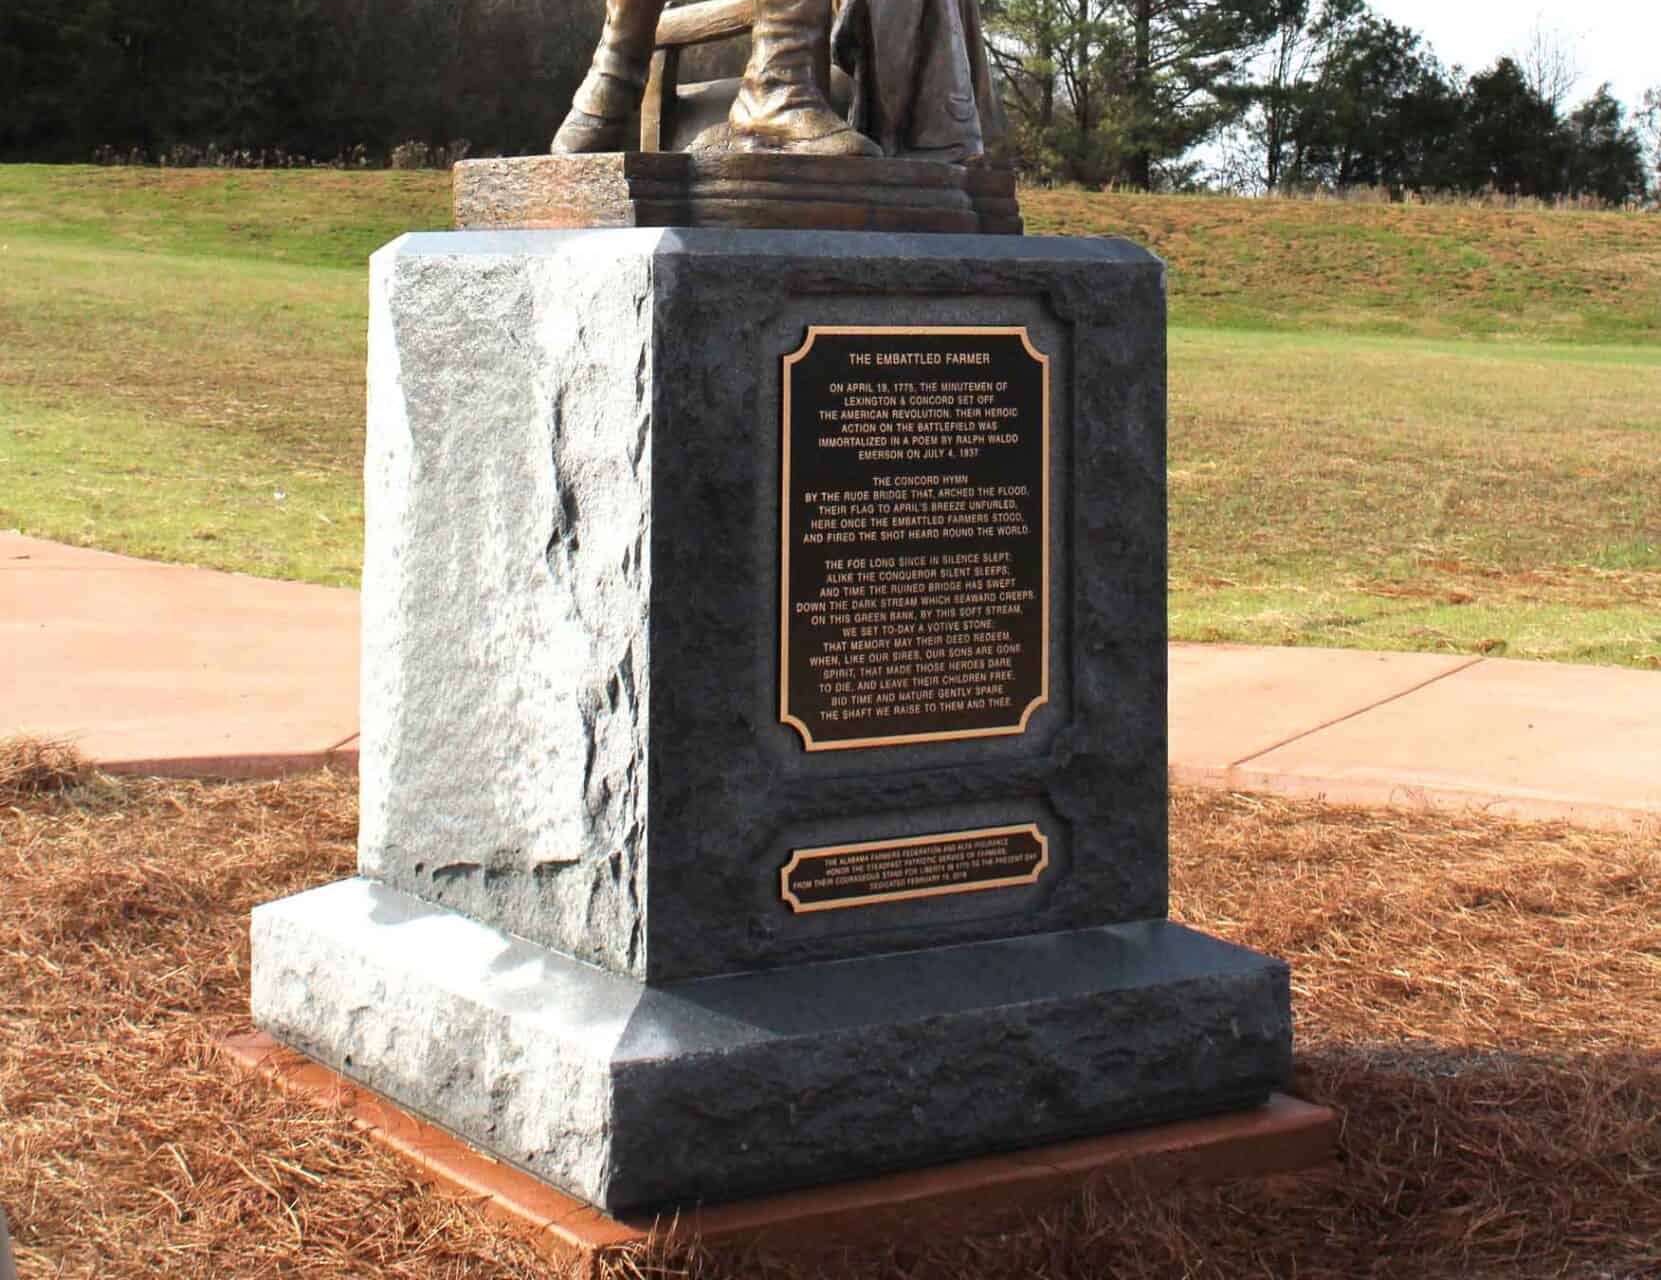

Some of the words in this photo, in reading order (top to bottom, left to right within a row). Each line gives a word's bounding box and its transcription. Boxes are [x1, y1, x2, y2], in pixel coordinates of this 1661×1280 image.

[850, 353, 871, 365] THE
[875, 353, 941, 365] EMBATTLED
[945, 353, 990, 365] FARMER
[829, 384, 843, 392] ON
[846, 383, 873, 392] APRIL
[920, 383, 936, 392] THE
[940, 382, 992, 392] MINUTEMEN
[995, 382, 1008, 392] OF
[844, 397, 896, 406] LEXINGTON
[908, 396, 954, 405] CONCORD
[957, 396, 973, 405] SET
[977, 396, 994, 404] OFF
[819, 411, 837, 420] THE
[840, 410, 888, 419] AMERICAN
[955, 409, 981, 418] THEIR
[984, 408, 1017, 418] HEROIC
[841, 424, 876, 433] ACTION
[879, 424, 892, 432] ON
[896, 423, 913, 432] THE
[917, 422, 974, 432] BATTLEFIELD
[978, 422, 998, 432] WAS
[819, 437, 886, 447] IMMORTALIZED
[912, 436, 937, 446] POEM
[940, 436, 952, 445] BY
[956, 435, 984, 445] RALPH
[988, 435, 1018, 444] WALDO
[859, 450, 903, 460] EMERSON
[906, 450, 920, 459] ON
[923, 449, 944, 459] JULY
[873, 477, 890, 486] THE
[894, 476, 939, 486] CONCORD
[942, 476, 968, 486] HYMN
[805, 493, 817, 503] BY
[821, 492, 839, 502] THE
[843, 491, 869, 502] RUDE
[873, 490, 907, 501] BRIDGE
[938, 488, 974, 499] ARCHED
[977, 488, 994, 498] THE
[819, 505, 846, 515] THEIR
[850, 504, 874, 514] FLAG
[878, 504, 890, 514] TO
[931, 502, 965, 512] BREEZE
[811, 519, 836, 529] HERE
[840, 518, 866, 528] ONCE
[870, 517, 888, 527] THE
[892, 516, 944, 526] EMBATTLED
[947, 514, 988, 524] FARMERS
[803, 533, 822, 543] AND
[826, 532, 855, 542] FIRED
[858, 531, 876, 541] THE
[880, 530, 904, 541] SHOT
[908, 529, 938, 540] HEARD
[942, 528, 973, 539] ROUND
[977, 528, 993, 537] THE
[825, 559, 843, 569] THE
[847, 558, 865, 568] FOE
[869, 557, 894, 568] LONG
[898, 556, 925, 566] SINCE
[942, 554, 979, 565] SILENCE
[827, 573, 853, 583] ALIKE
[857, 572, 874, 582] THE
[878, 570, 936, 581] CONQUEROR
[940, 568, 970, 578] SILENT
[820, 587, 839, 597] AND
[843, 586, 865, 596] TIME
[869, 585, 886, 595] THE
[890, 583, 924, 594] RUINED
[928, 582, 961, 592] BRIDGE
[965, 581, 982, 590] HAS
[986, 579, 1014, 589] SWEPT
[796, 601, 825, 612] DOWN
[829, 600, 847, 611] THE
[851, 599, 876, 610] DARK
[880, 597, 917, 608] STREAM
[920, 595, 950, 606] WHICH
[954, 593, 996, 605] SEAWARD
[811, 615, 825, 625] ON
[829, 614, 850, 624] THIS
[854, 612, 886, 623] GREEN
[920, 610, 932, 620] BY
[936, 609, 955, 619] THIS
[959, 608, 981, 618] SOFT
[842, 627, 856, 637] WE
[860, 626, 878, 636] SET
[927, 622, 959, 633] VOTIVE
[824, 641, 846, 651] THAT
[850, 639, 890, 650] MEMORY
[894, 638, 912, 648] MAY
[916, 636, 942, 647] THEIR
[946, 634, 969, 645] DEED
[844, 654, 864, 665] LIKE
[868, 653, 888, 663] OUR
[925, 649, 945, 660] OUR
[948, 648, 972, 658] SONS
[975, 647, 992, 657] ARE
[859, 667, 882, 677] THAT
[886, 665, 911, 676] MADE
[915, 663, 944, 674] THOSE
[948, 660, 984, 672] HEROES
[987, 659, 1010, 670] DARE
[819, 683, 831, 693] TO
[857, 680, 876, 691] AND
[879, 678, 908, 689] LEAVE
[912, 676, 938, 687] THEIR
[941, 673, 986, 686] CHILDREN
[832, 696, 847, 706] BID
[851, 694, 872, 704] TIME
[876, 692, 895, 703] AND
[898, 690, 933, 701] NATURE
[937, 687, 971, 698] GENTLY
[975, 685, 1003, 696] SPARE
[821, 710, 838, 721] THE
[842, 708, 871, 719] SHAFT
[875, 707, 889, 717] WE
[893, 704, 920, 716] RAISE
[924, 703, 936, 713] TO
[940, 701, 964, 712] THEM
[967, 700, 985, 710] AND
